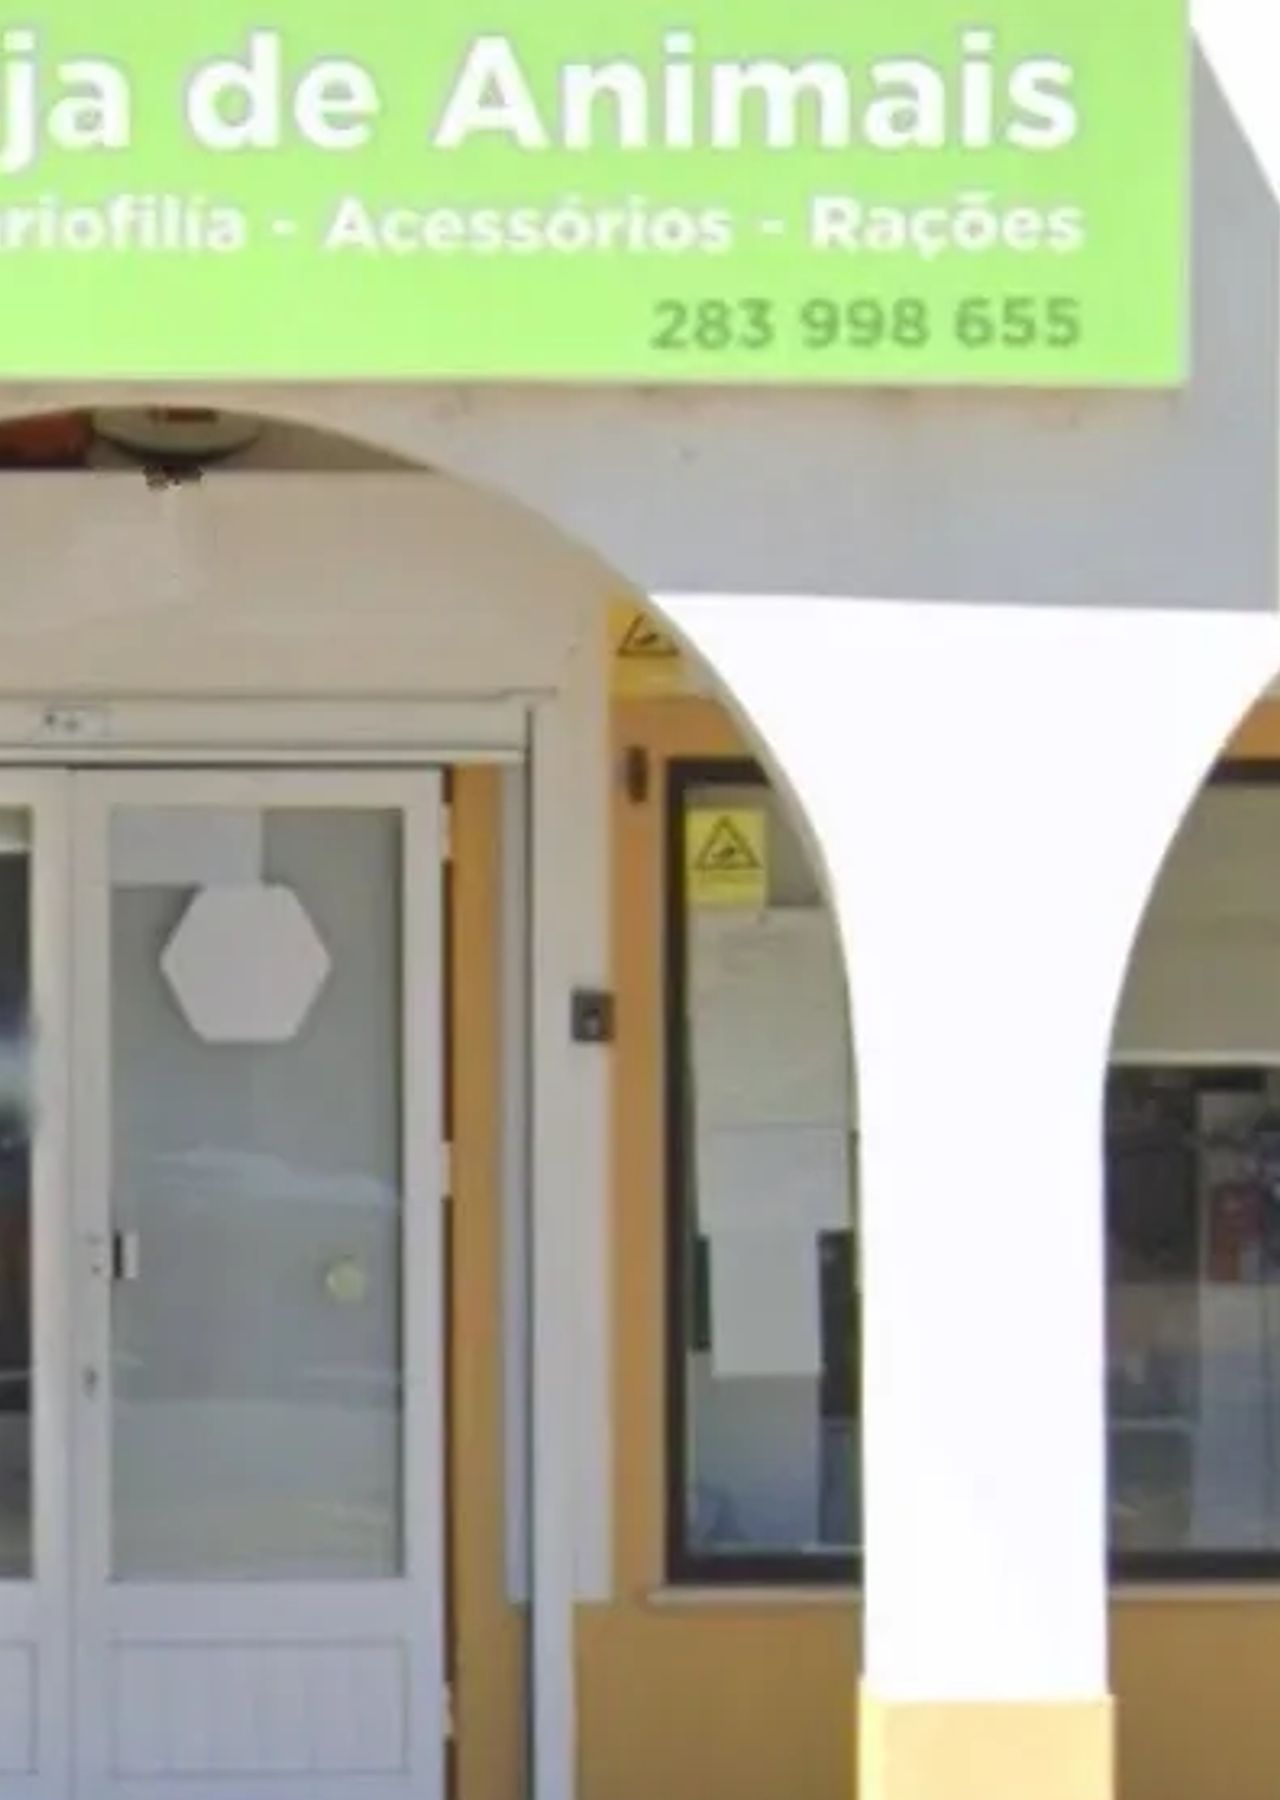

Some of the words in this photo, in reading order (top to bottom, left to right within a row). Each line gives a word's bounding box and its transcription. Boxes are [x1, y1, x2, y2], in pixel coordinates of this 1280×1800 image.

[184, 30, 378, 149] de
[433, 30, 1078, 148] Animais
[321, 193, 735, 252] Acessórios
[807, 191, 1084, 259] Rações
[652, 299, 773, 349] 283
[801, 298, 929, 347] 998
[954, 297, 1080, 347] 655
